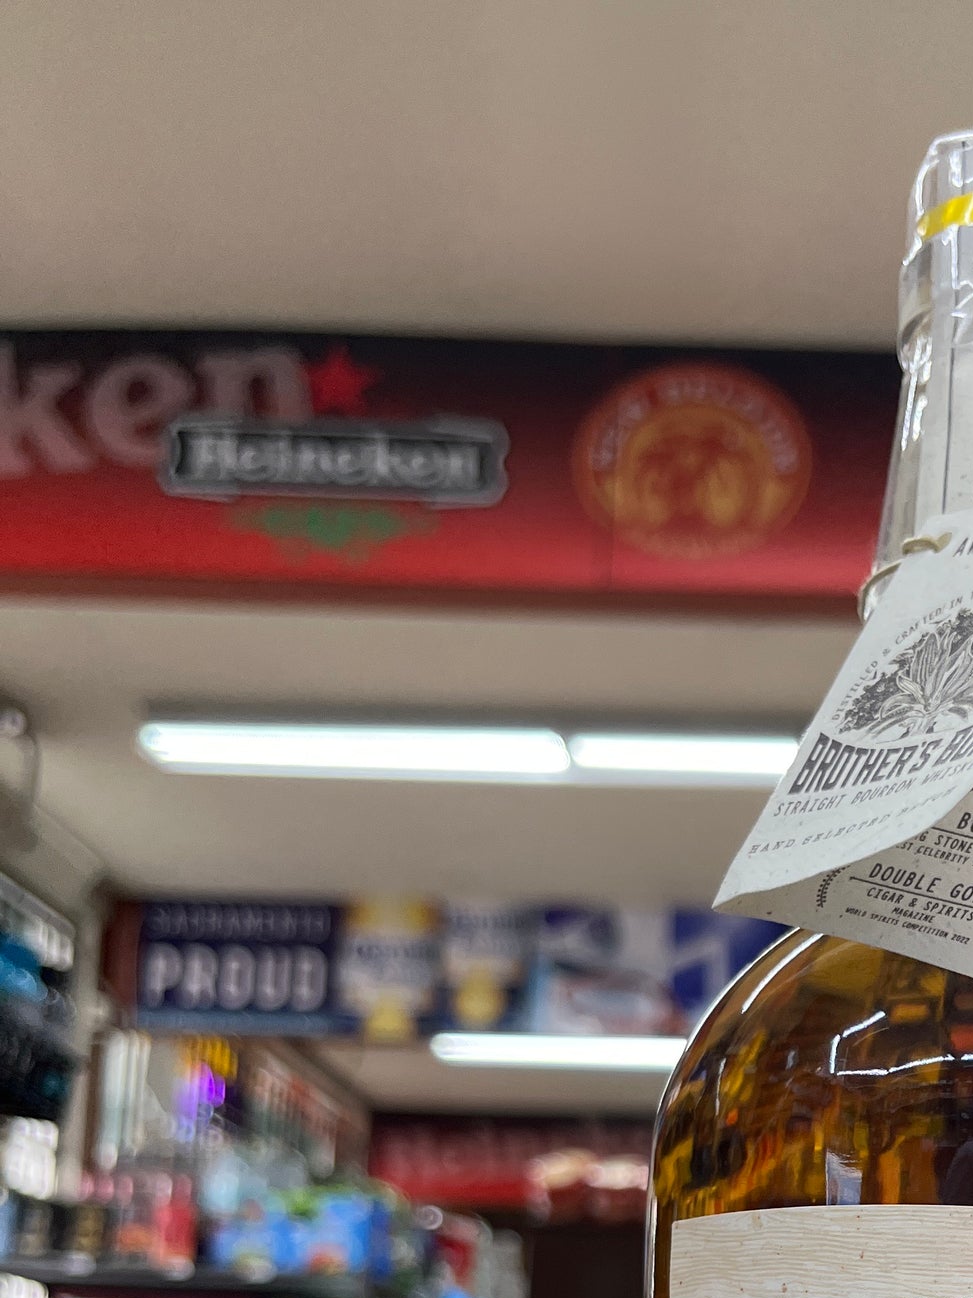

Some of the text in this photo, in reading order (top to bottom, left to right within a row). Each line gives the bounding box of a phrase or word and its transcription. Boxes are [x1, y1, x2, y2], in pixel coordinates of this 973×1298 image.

[832, 660, 878, 721] DISTILLED
[895, 606, 943, 645] CRAFTED
[949, 595, 963, 611] IN
[788, 732, 944, 795] BROTHER'S
[773, 793, 847, 817] STRAIGHT
[850, 777, 916, 805] BOURBON
[749, 837, 796, 855] HAND
[801, 813, 892, 846] SELECTED
[916, 845, 969, 865] CELEBRITY
[868, 862, 941, 893] DOUBLE
[866, 887, 904, 904] CIGAR
[908, 897, 917, 908] &
[892, 906, 936, 924] MAGAZINE
[845, 907, 970, 945] WORLD SPIRITS COMPETITION 2022
[144, 941, 328, 1011] PROUD
